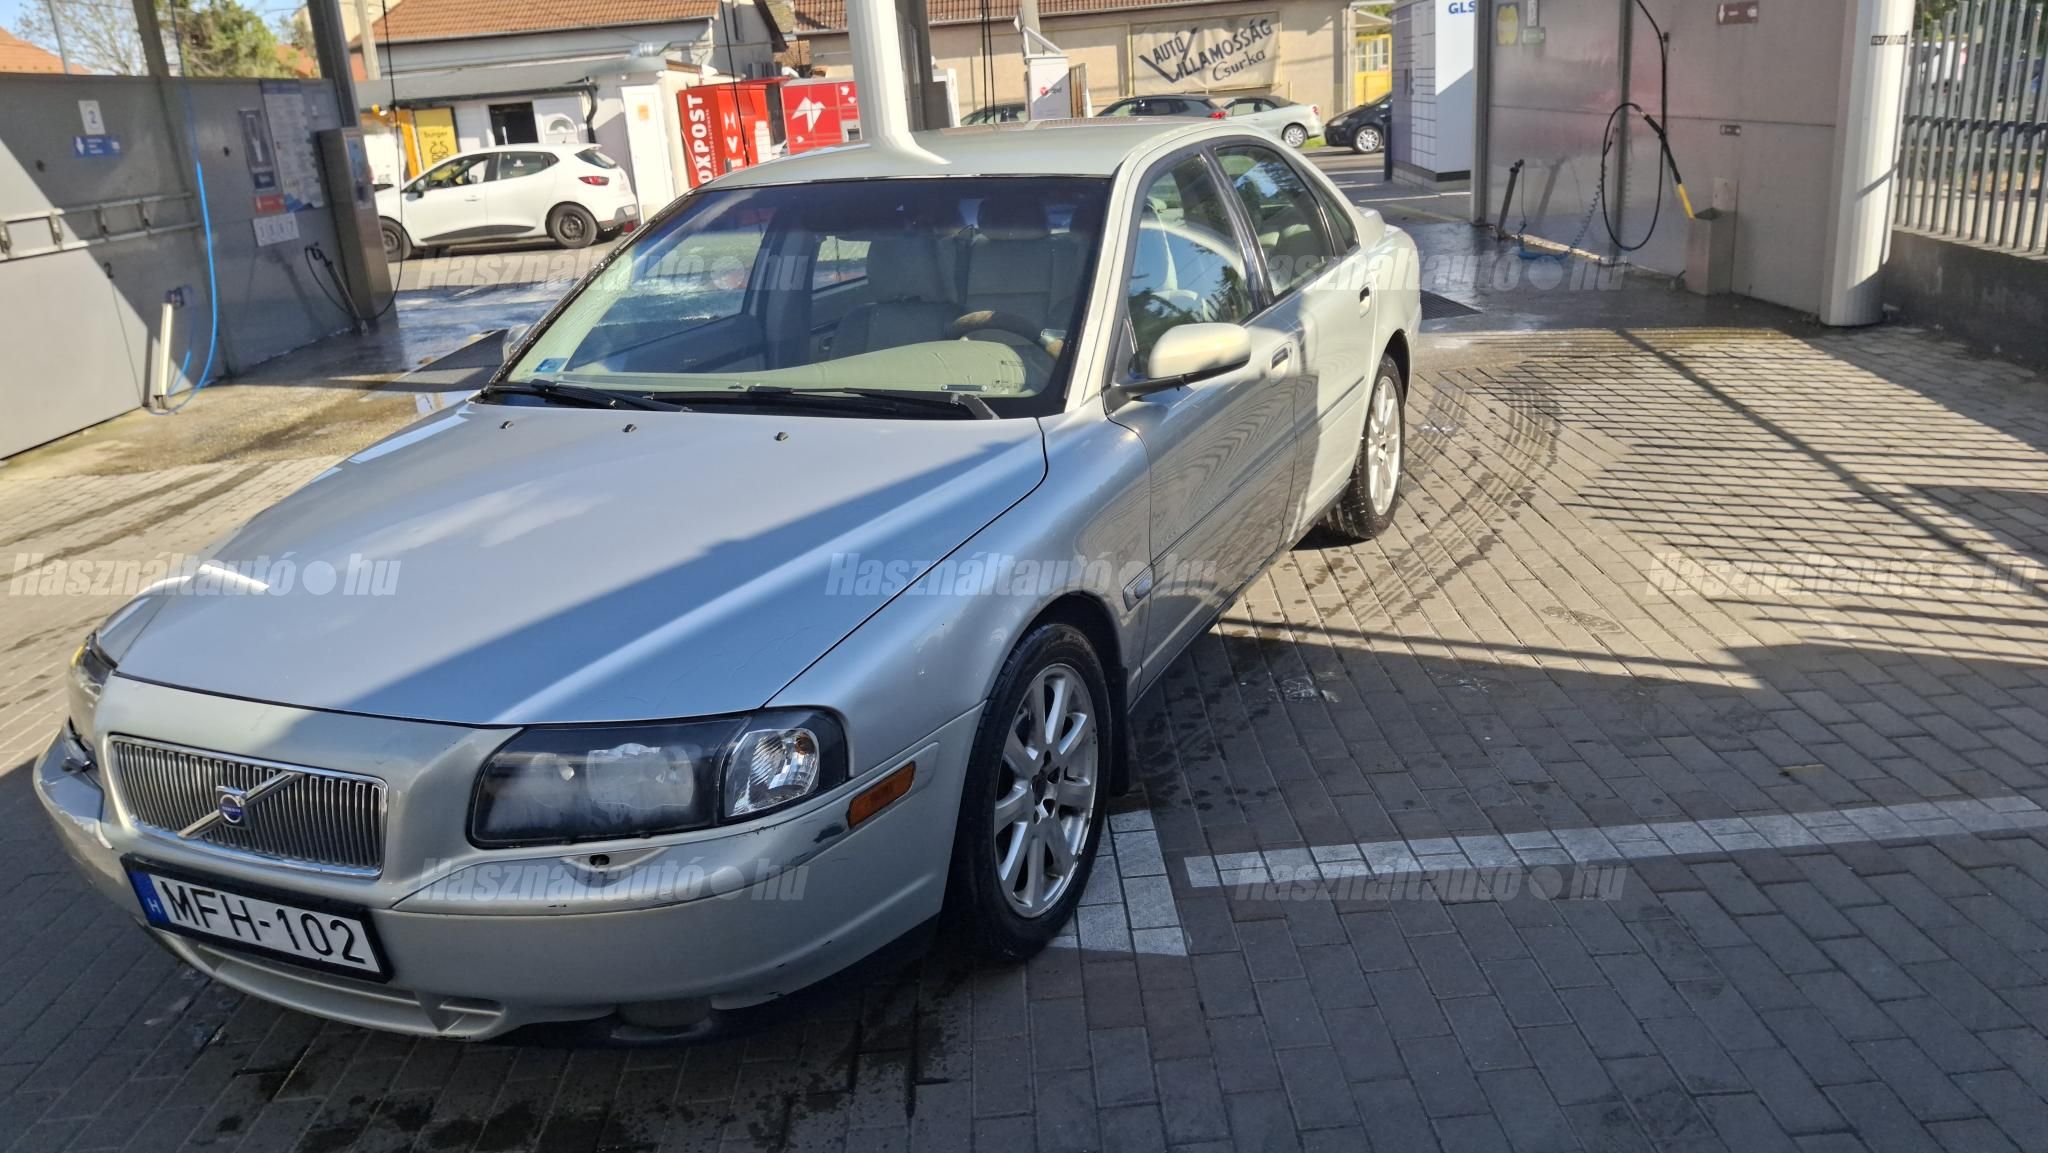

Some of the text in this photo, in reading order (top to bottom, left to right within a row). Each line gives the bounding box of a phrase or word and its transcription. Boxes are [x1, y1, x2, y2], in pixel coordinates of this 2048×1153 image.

[1448, 0, 1476, 14] GLS
[1138, 18, 1273, 84] VILLAMOSSÁG
[1152, 31, 1185, 65] AUTÓ
[1212, 49, 1266, 82] Csurka
[88, 110, 98, 124] 2
[687, 94, 714, 184] OXPOST
[147, 897, 163, 915] H
[160, 880, 367, 964] MFH-102
